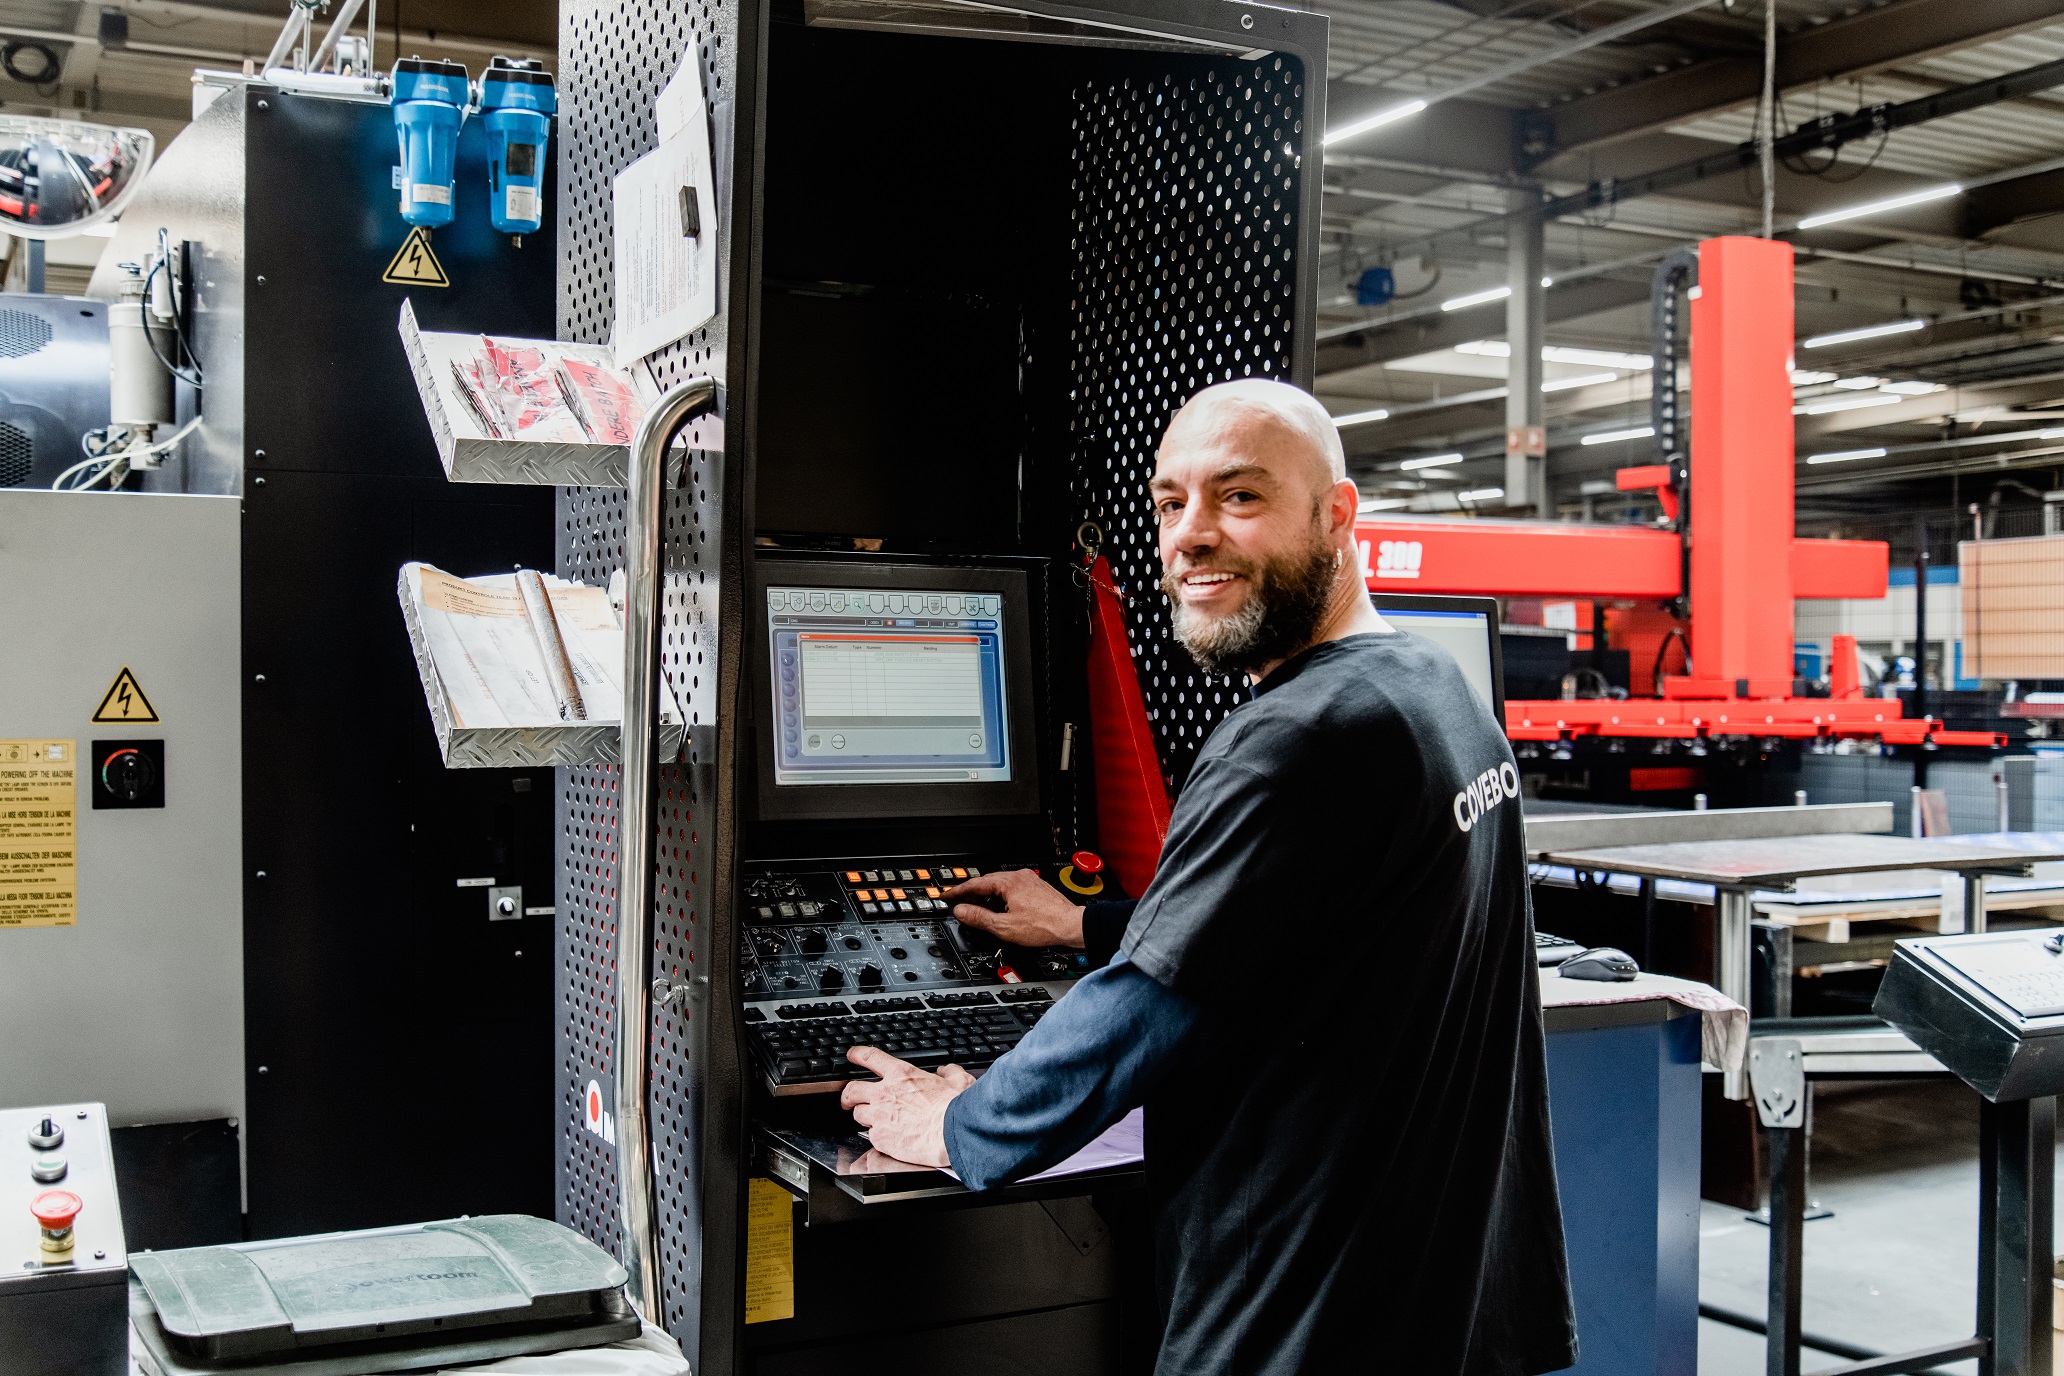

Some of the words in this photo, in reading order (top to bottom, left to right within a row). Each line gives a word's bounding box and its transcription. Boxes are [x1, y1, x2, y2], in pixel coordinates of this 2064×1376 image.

[1377, 540, 1422, 570] 300
[1454, 762, 1518, 832] COVEBO
[360, 1272, 478, 1287] overtoom
